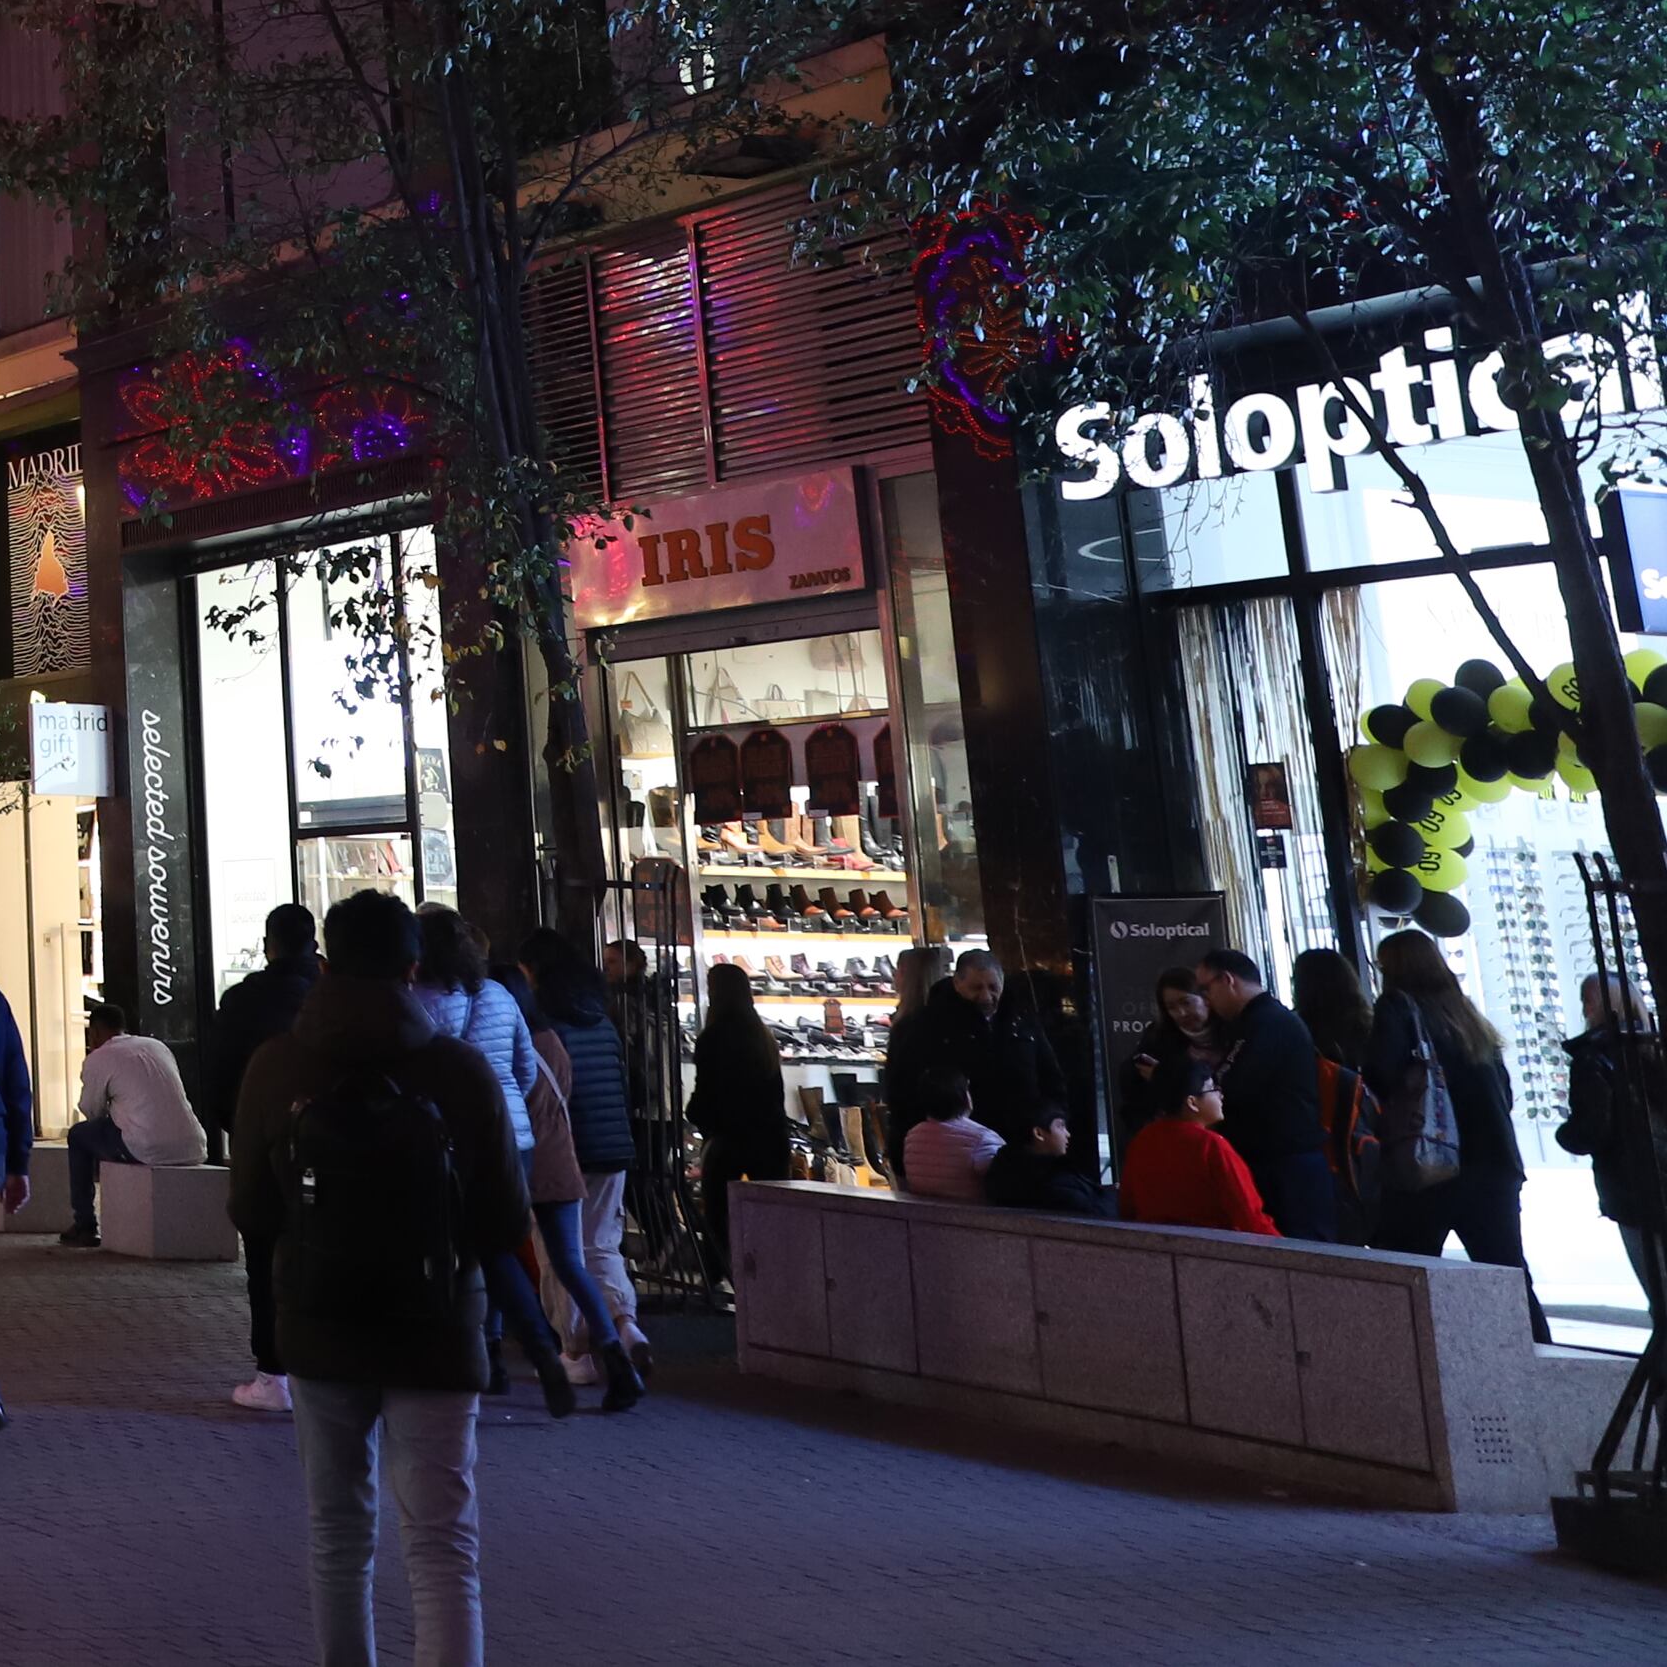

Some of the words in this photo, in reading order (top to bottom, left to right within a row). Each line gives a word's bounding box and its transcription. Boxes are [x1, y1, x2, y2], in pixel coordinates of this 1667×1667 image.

[1054, 290, 1667, 502] Soloptical
[640, 514, 775, 586] IRIS
[789, 567, 851, 590] ZAPATOS
[38, 708, 109, 732] madrid
[39, 733, 74, 759] gift
[141, 709, 176, 843] selected
[147, 844, 180, 1006] souvenirs
[1130, 923, 1210, 941] Soloptical
